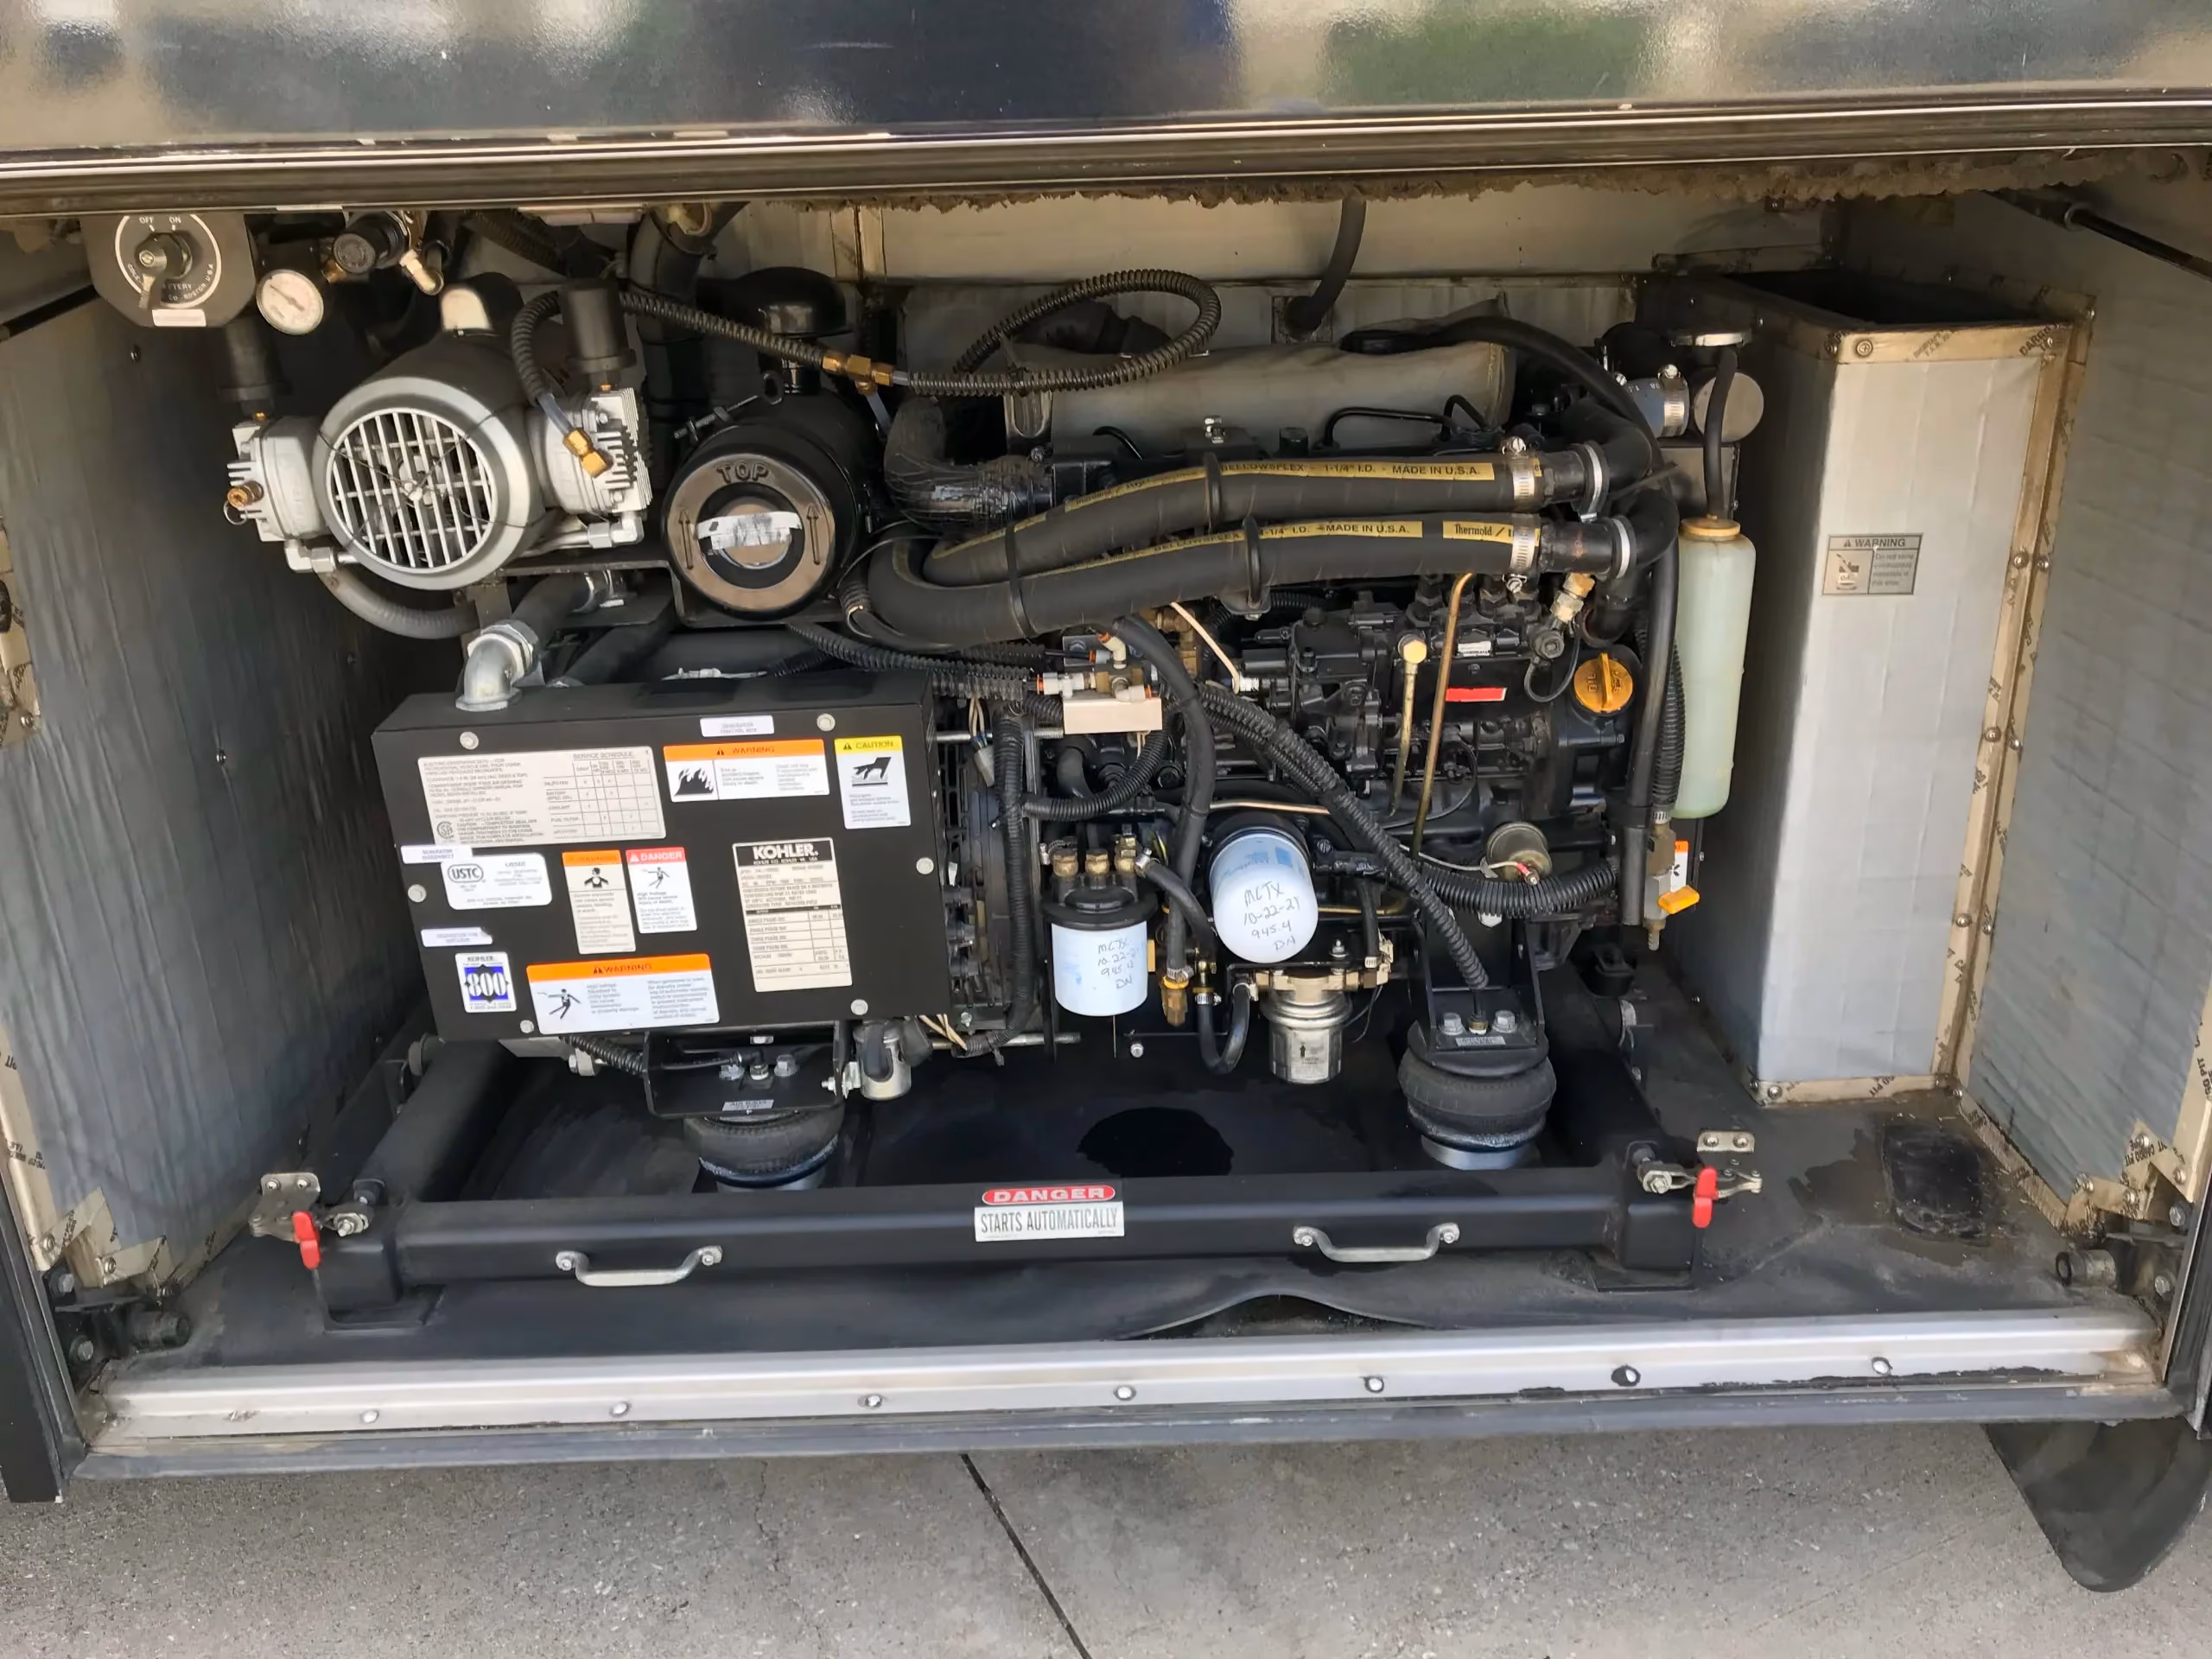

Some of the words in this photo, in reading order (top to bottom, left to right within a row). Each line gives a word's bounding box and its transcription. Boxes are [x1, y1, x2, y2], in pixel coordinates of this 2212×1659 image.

[716, 460, 769, 484] TOP
[1357, 464, 1376, 473] I.D.
[1392, 464, 1427, 474] MADE
[1430, 465, 1442, 474] IN
[1445, 466, 1480, 474] U.S.A.
[1325, 524, 1358, 533] MADE
[1362, 524, 1373, 533] IN
[1376, 524, 1410, 533] U.S.A.
[1854, 538, 1905, 547] WARNING
[856, 741, 893, 749] CAUTION
[640, 851, 683, 861] DANGER
[451, 868, 480, 880] USTC
[1244, 880, 1285, 906] MCTX
[604, 963, 652, 974] WARNING
[467, 972, 506, 997] 800
[994, 1188, 1105, 1202] DANGER
[981, 1211, 1022, 1234] STARTS
[1027, 1208, 1117, 1231] AUTOMATICALLY
